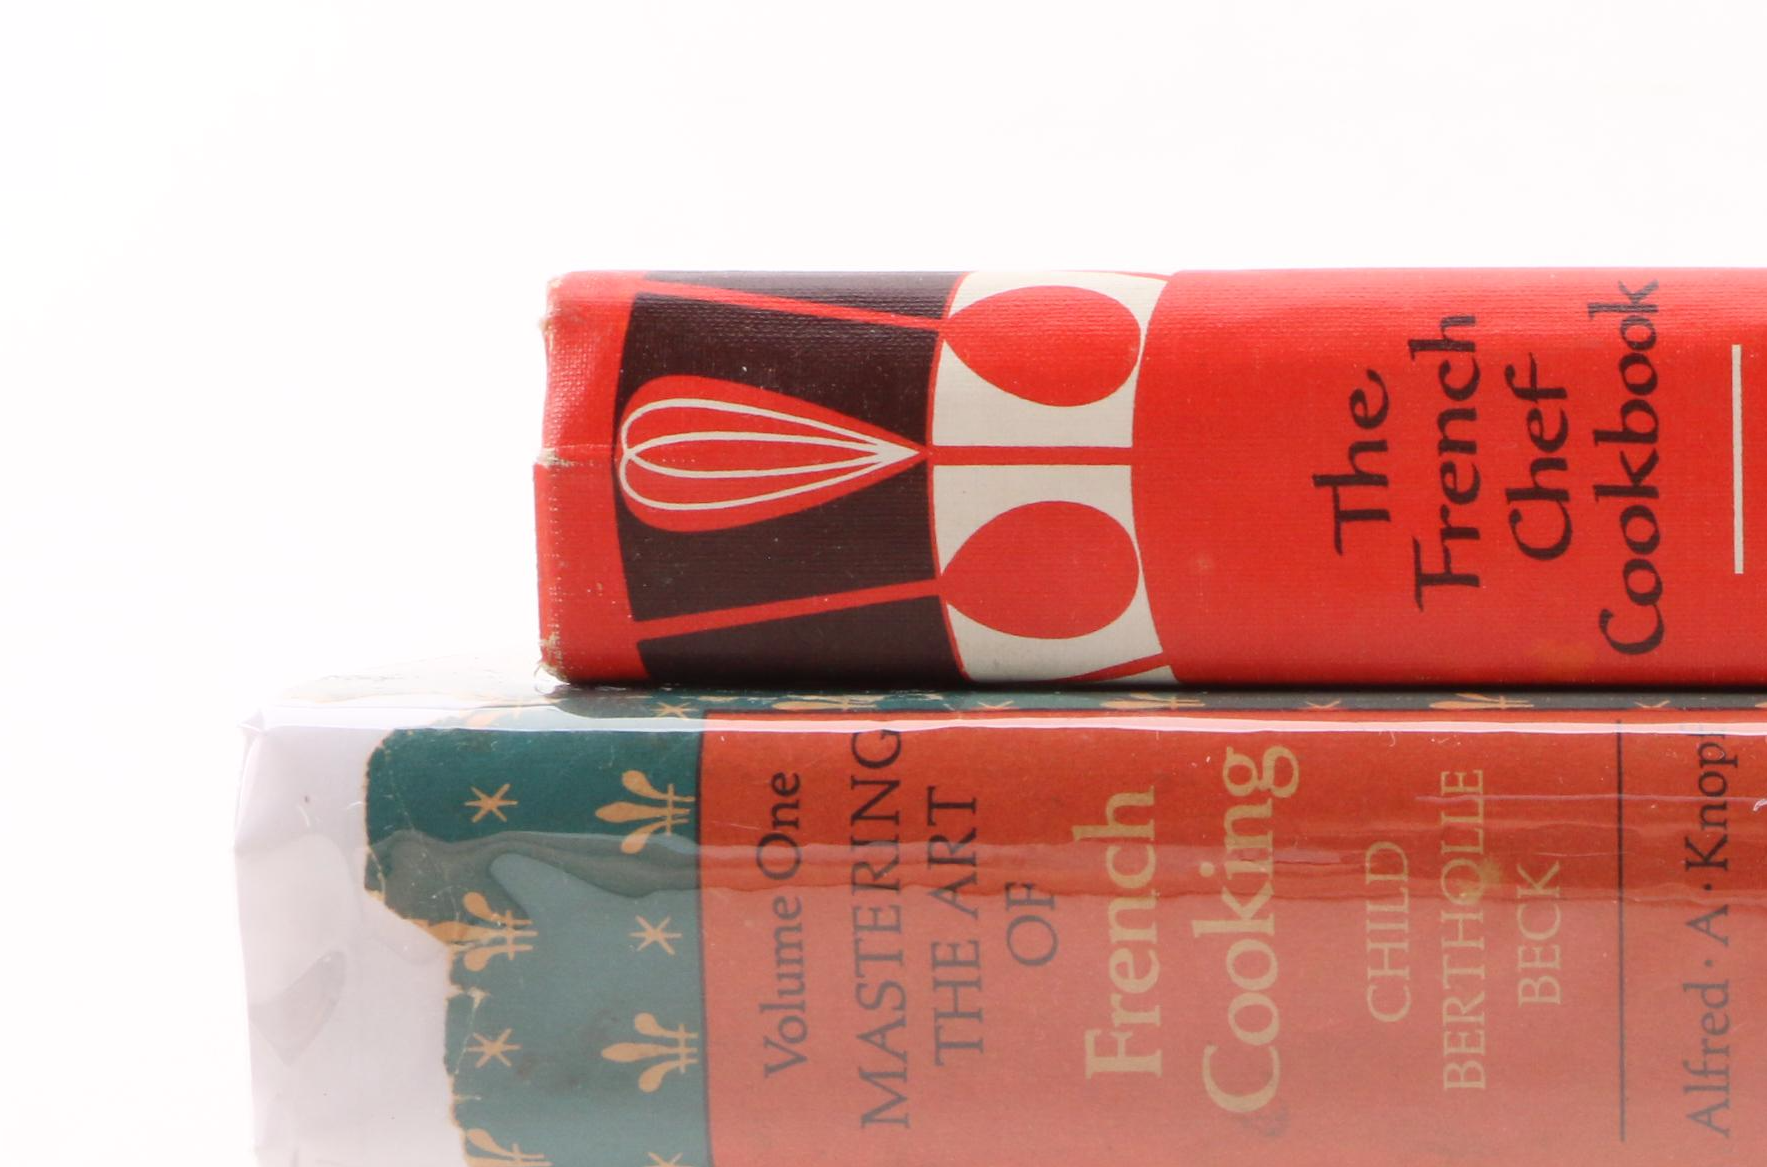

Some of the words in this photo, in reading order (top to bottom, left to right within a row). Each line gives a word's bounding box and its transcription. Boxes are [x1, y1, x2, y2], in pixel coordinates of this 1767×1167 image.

[1312, 369, 1392, 556] The
[1408, 313, 1482, 612] French
[1504, 352, 1573, 562] Chef
[1587, 278, 1665, 656] Cookbook
[755, 770, 803, 882] One
[926, 784, 980, 921] ART
[1684, 733, 1739, 873] Knop
[758, 895, 809, 1080] Volume
[849, 729, 911, 1131] MASTERING
[930, 938, 985, 1068] THE
[1004, 879, 1059, 968] OF
[1072, 784, 1164, 1081] French
[1192, 744, 1300, 1115] Cooking
[1364, 840, 1412, 1024] CHILD
[1439, 768, 1487, 1092] BERTHOLLE
[1515, 860, 1562, 1008] BECK
[1683, 978, 1731, 1139] Alfred
